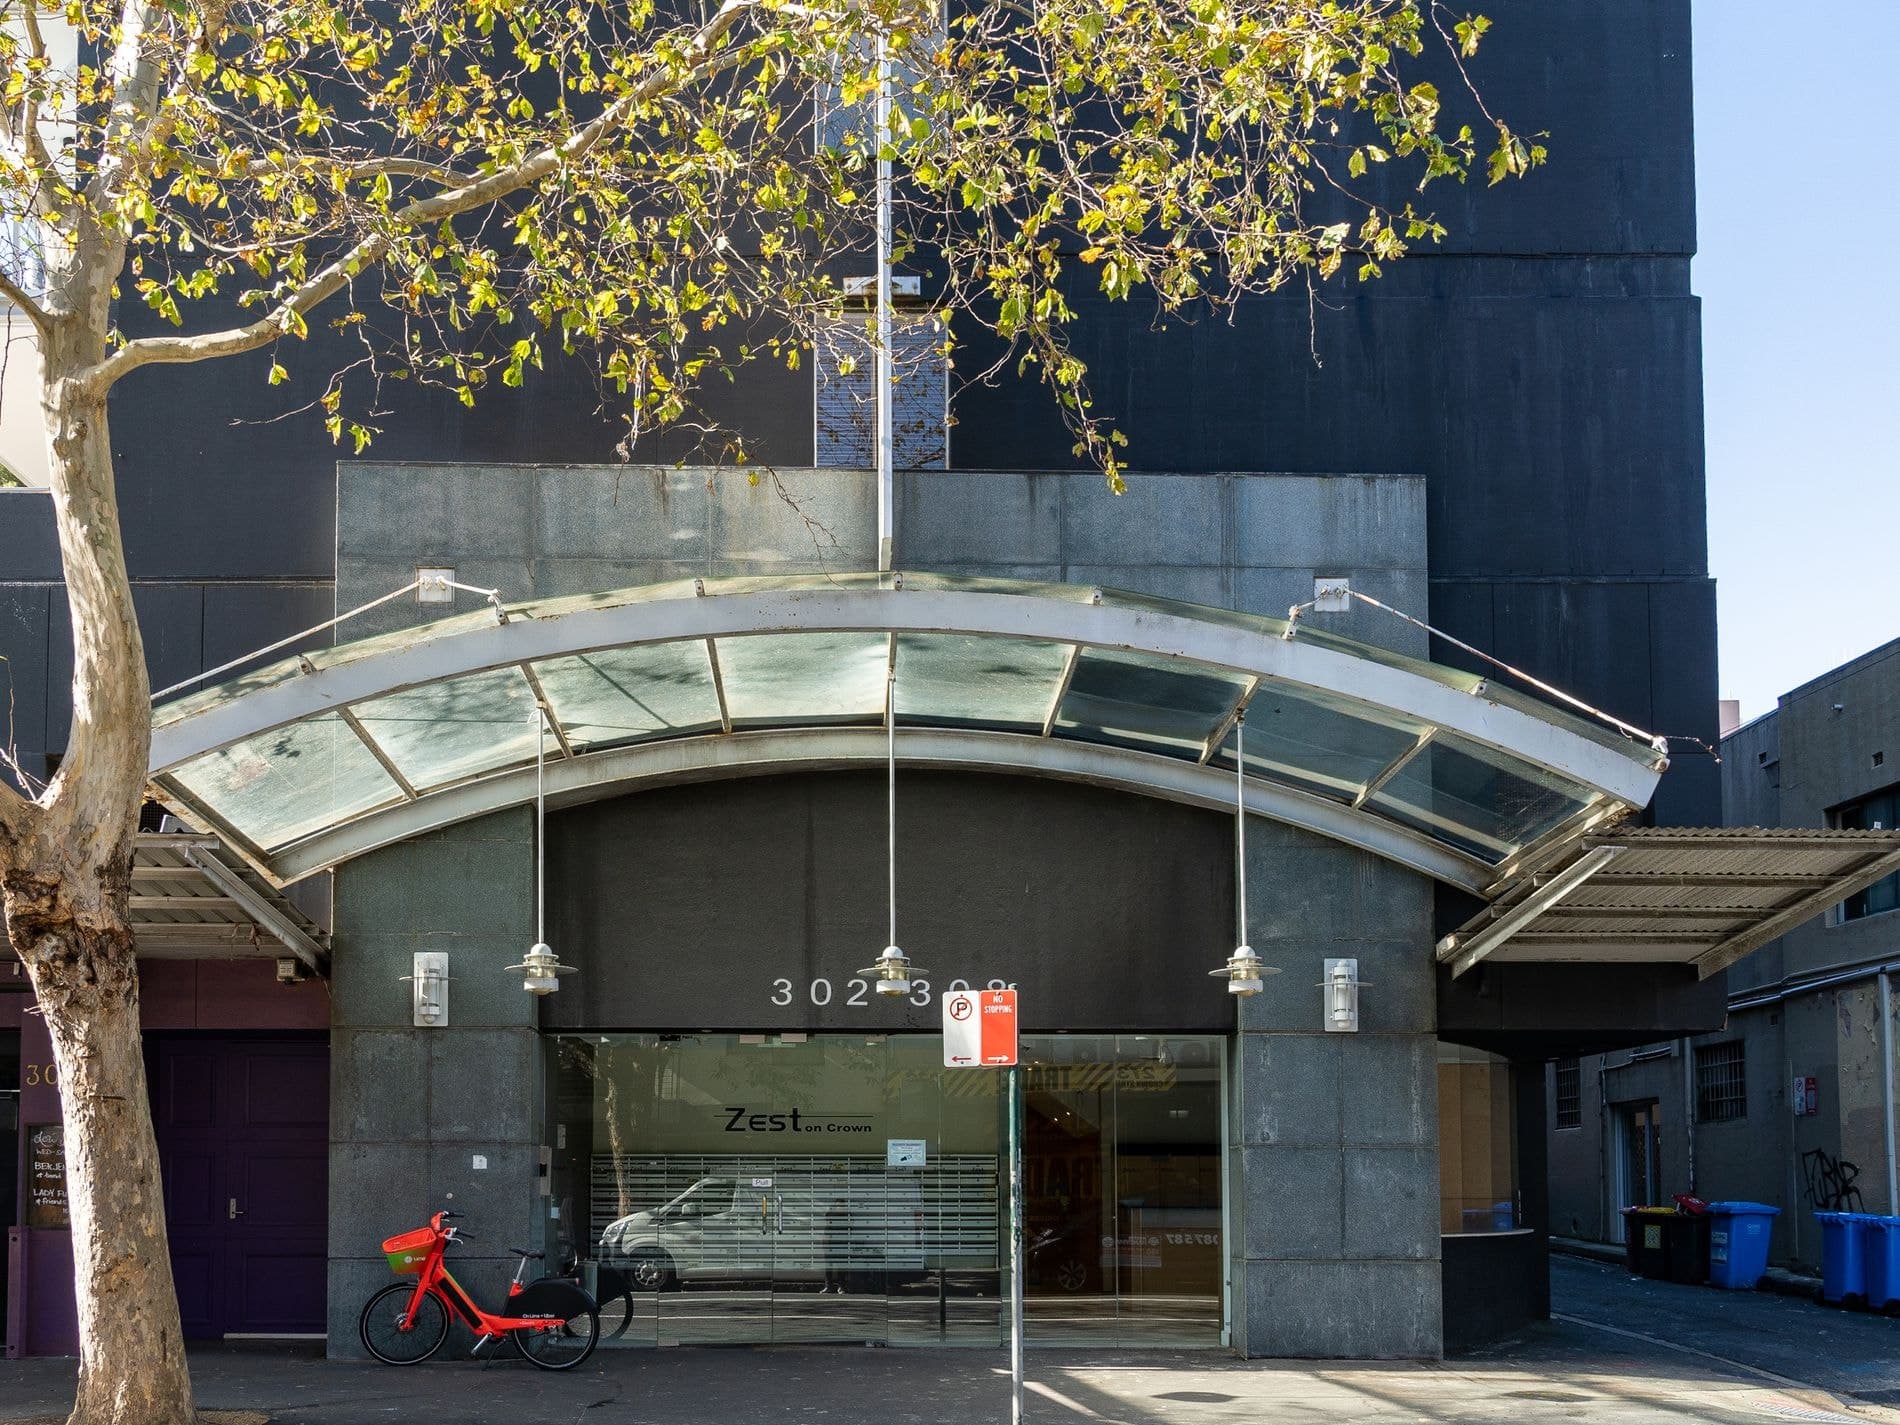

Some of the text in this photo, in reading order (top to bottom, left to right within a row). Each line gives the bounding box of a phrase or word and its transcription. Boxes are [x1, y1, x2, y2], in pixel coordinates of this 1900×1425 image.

[770, 978, 868, 1006] 302
[992, 995, 1003, 1004] NO
[984, 1005, 1012, 1014] STOPPING
[724, 1107, 872, 1132] Zest on Crown
[755, 1178, 769, 1187] Pull
